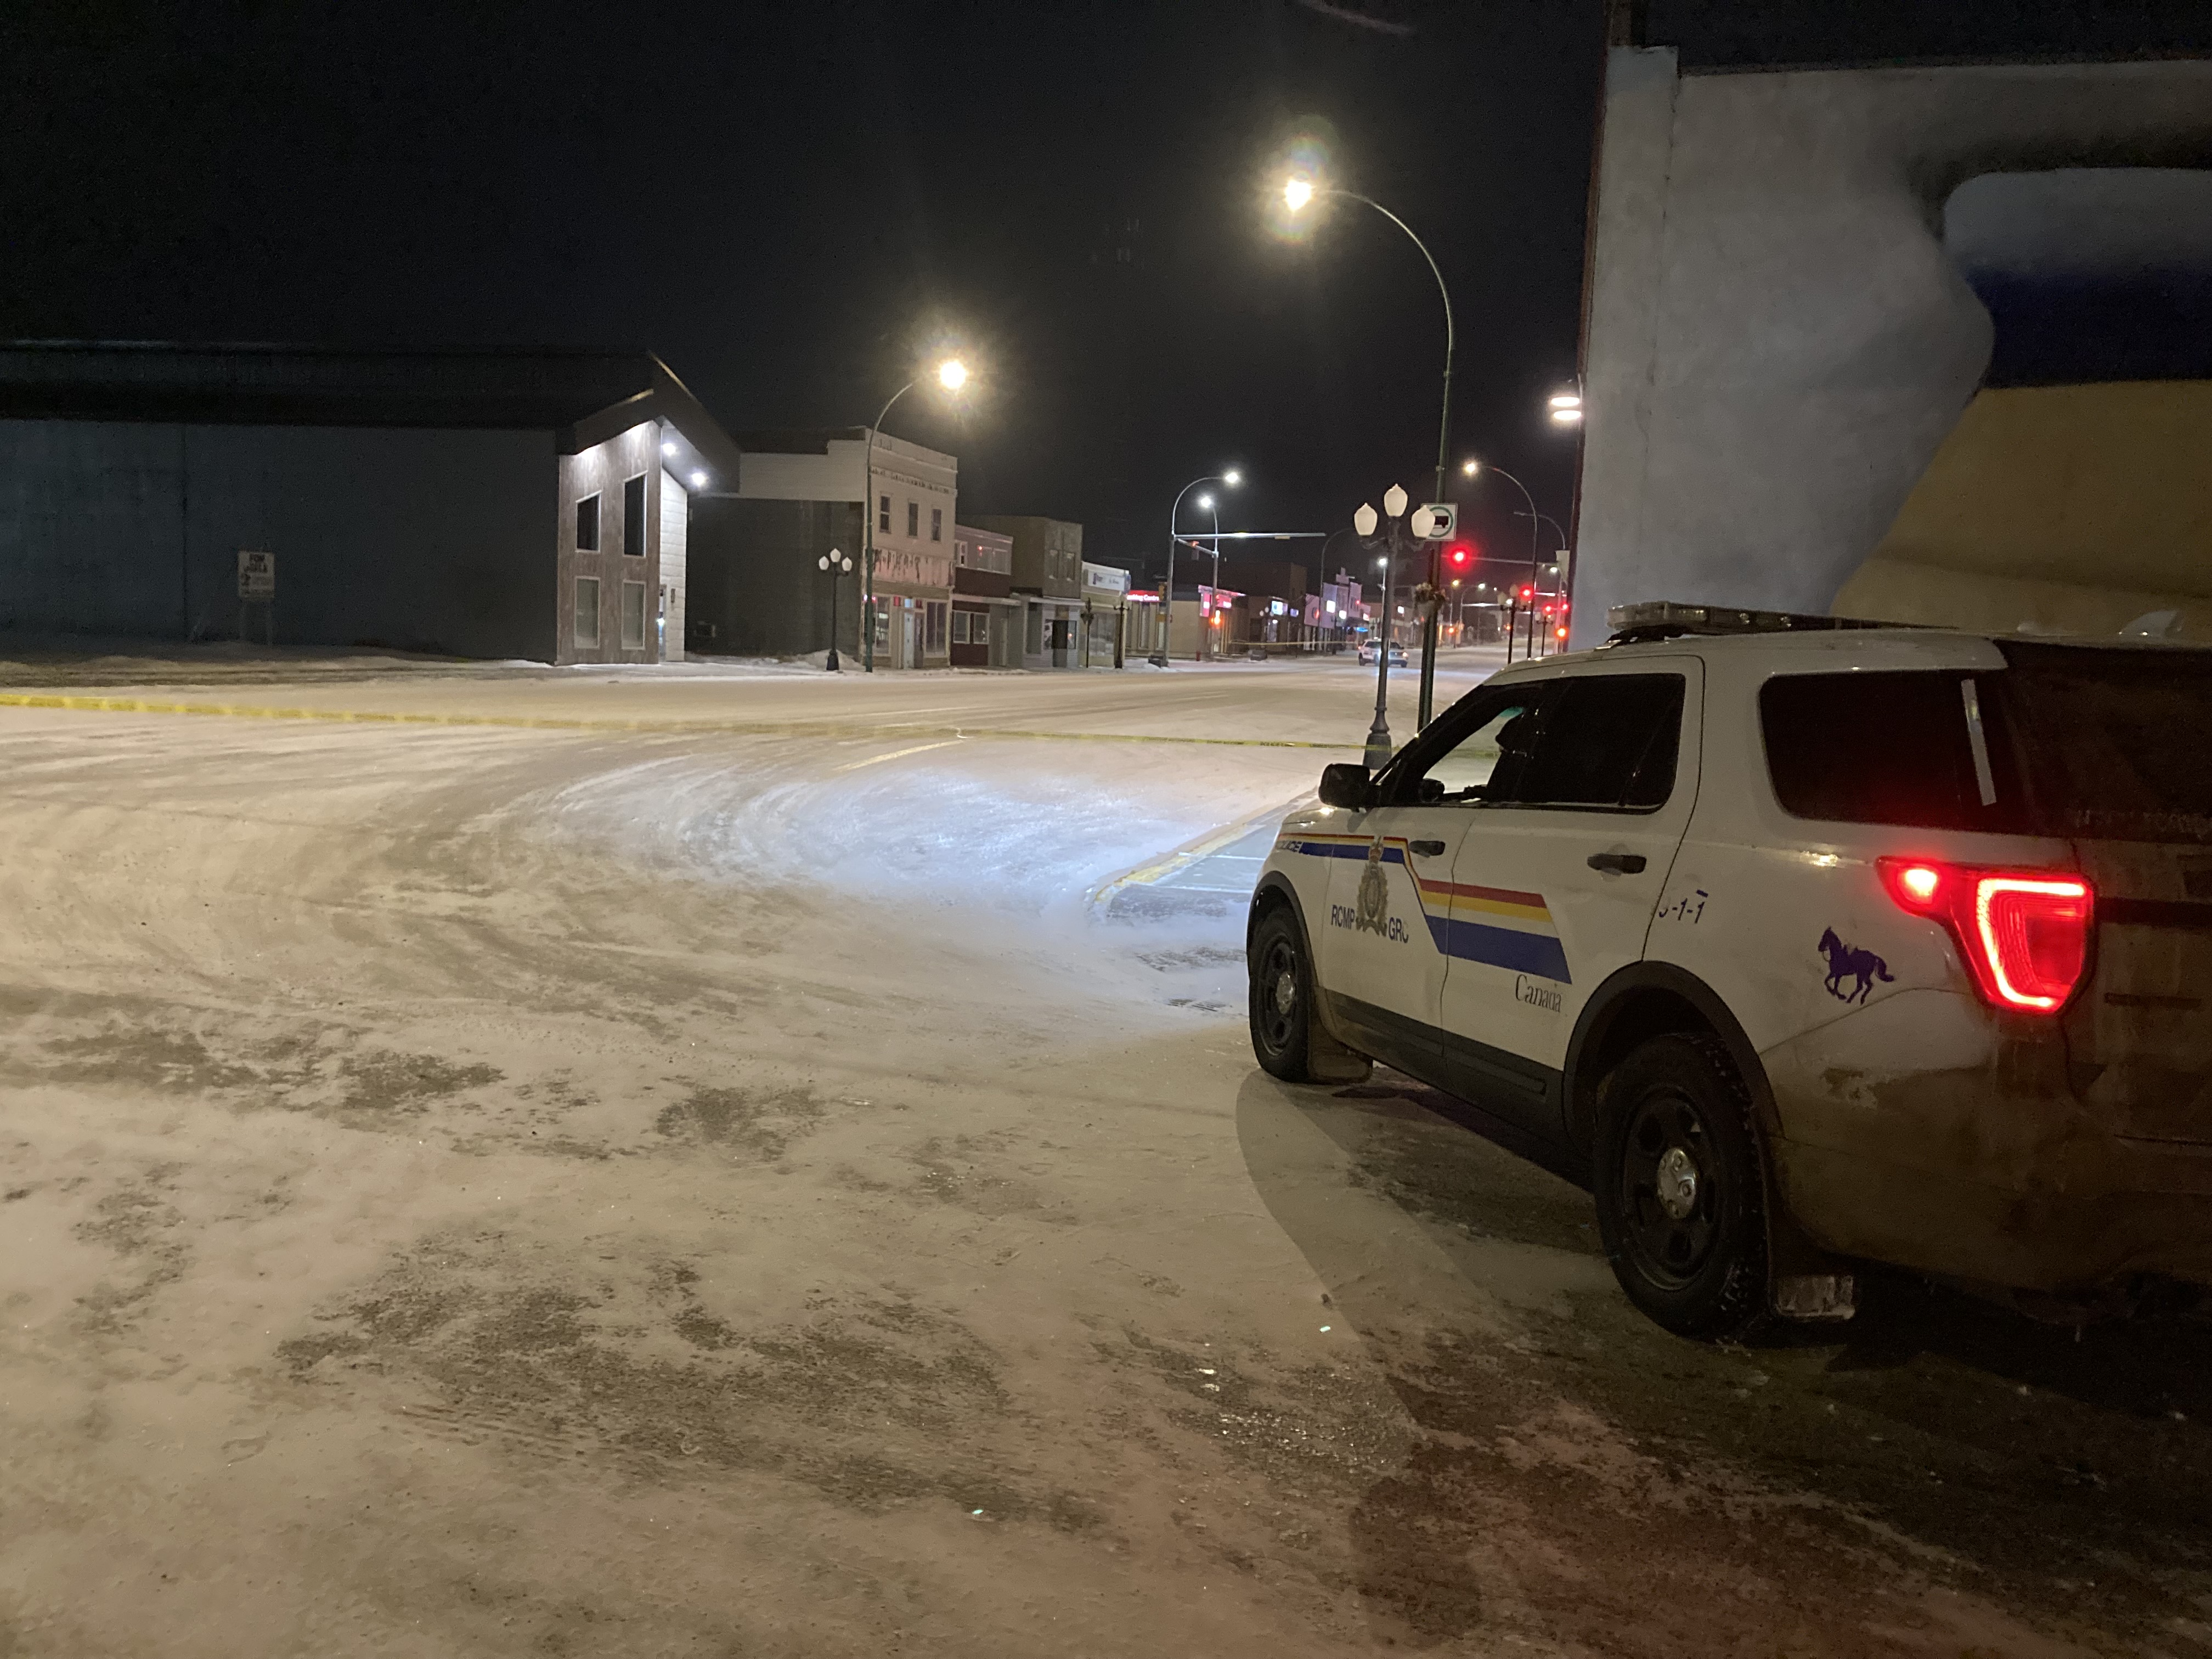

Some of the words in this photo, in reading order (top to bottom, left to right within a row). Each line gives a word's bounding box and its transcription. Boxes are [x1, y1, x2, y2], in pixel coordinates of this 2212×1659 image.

[1331, 904, 1355, 930] RCMP
[1388, 916, 1409, 944] GRC
[1515, 974, 1562, 1013] Canada
